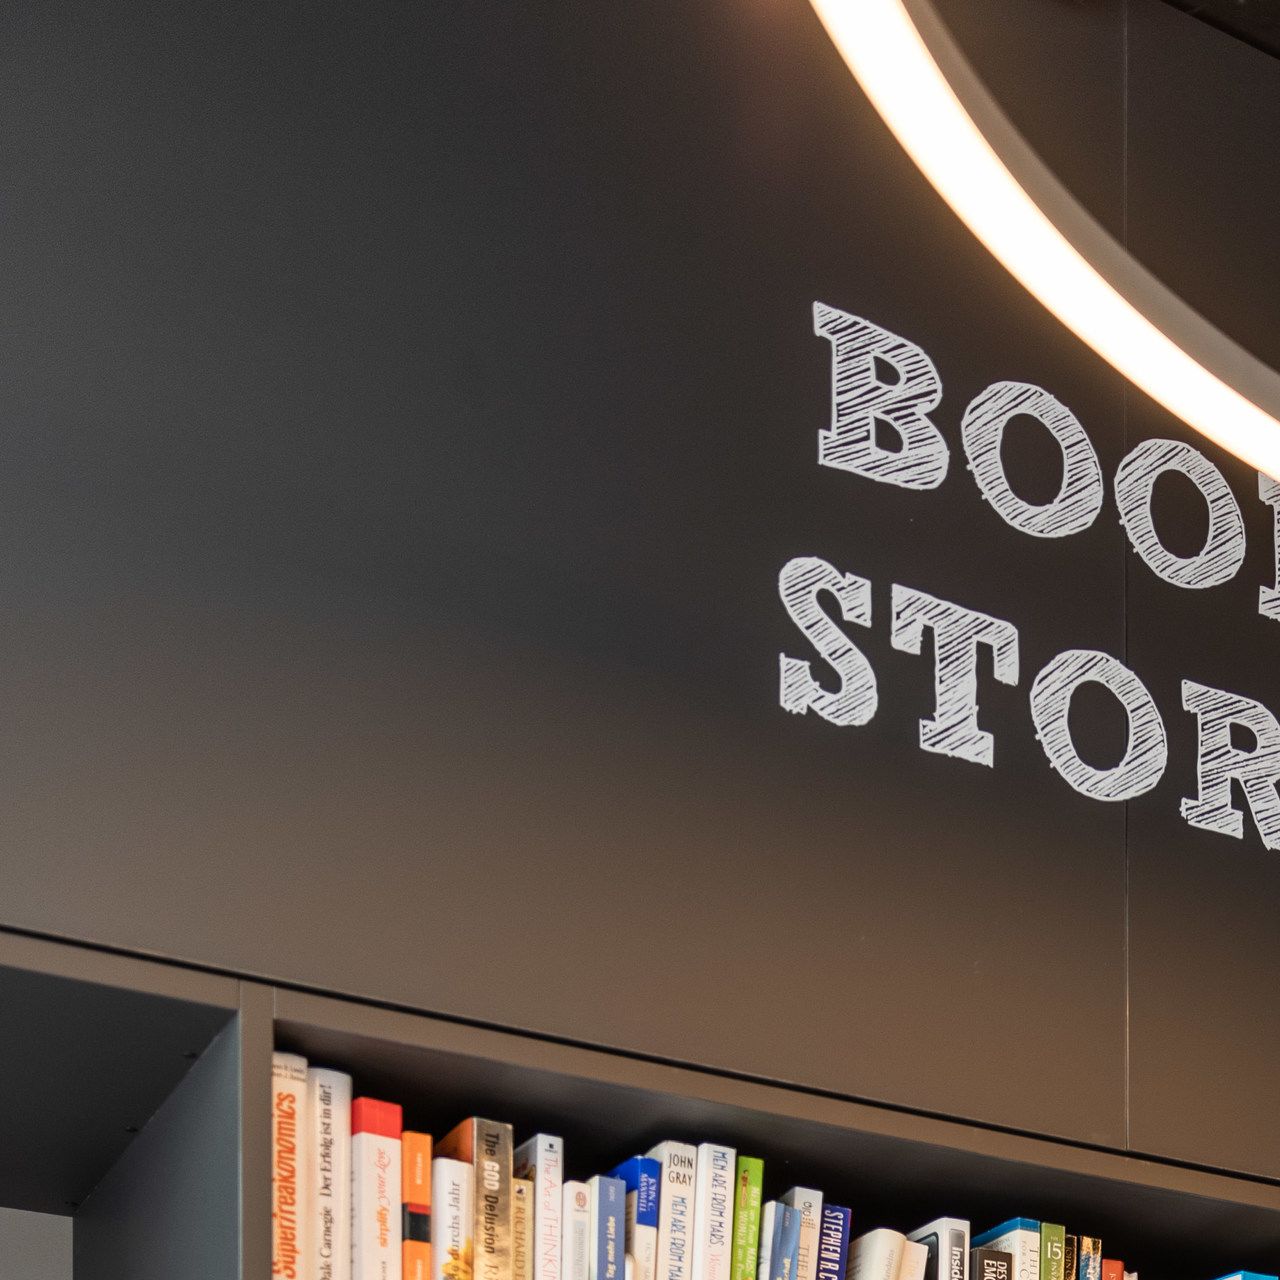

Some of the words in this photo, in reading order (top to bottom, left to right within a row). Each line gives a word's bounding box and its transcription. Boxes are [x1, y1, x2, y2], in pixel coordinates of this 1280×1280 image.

[485, 1132, 500, 1157] The
[668, 1152, 693, 1170] JOHN
[485, 1161, 500, 1191] GOD
[669, 1172, 692, 1187] GRAY
[485, 1193, 499, 1255] Delusion
[823, 1209, 844, 1255] STEPHEN
